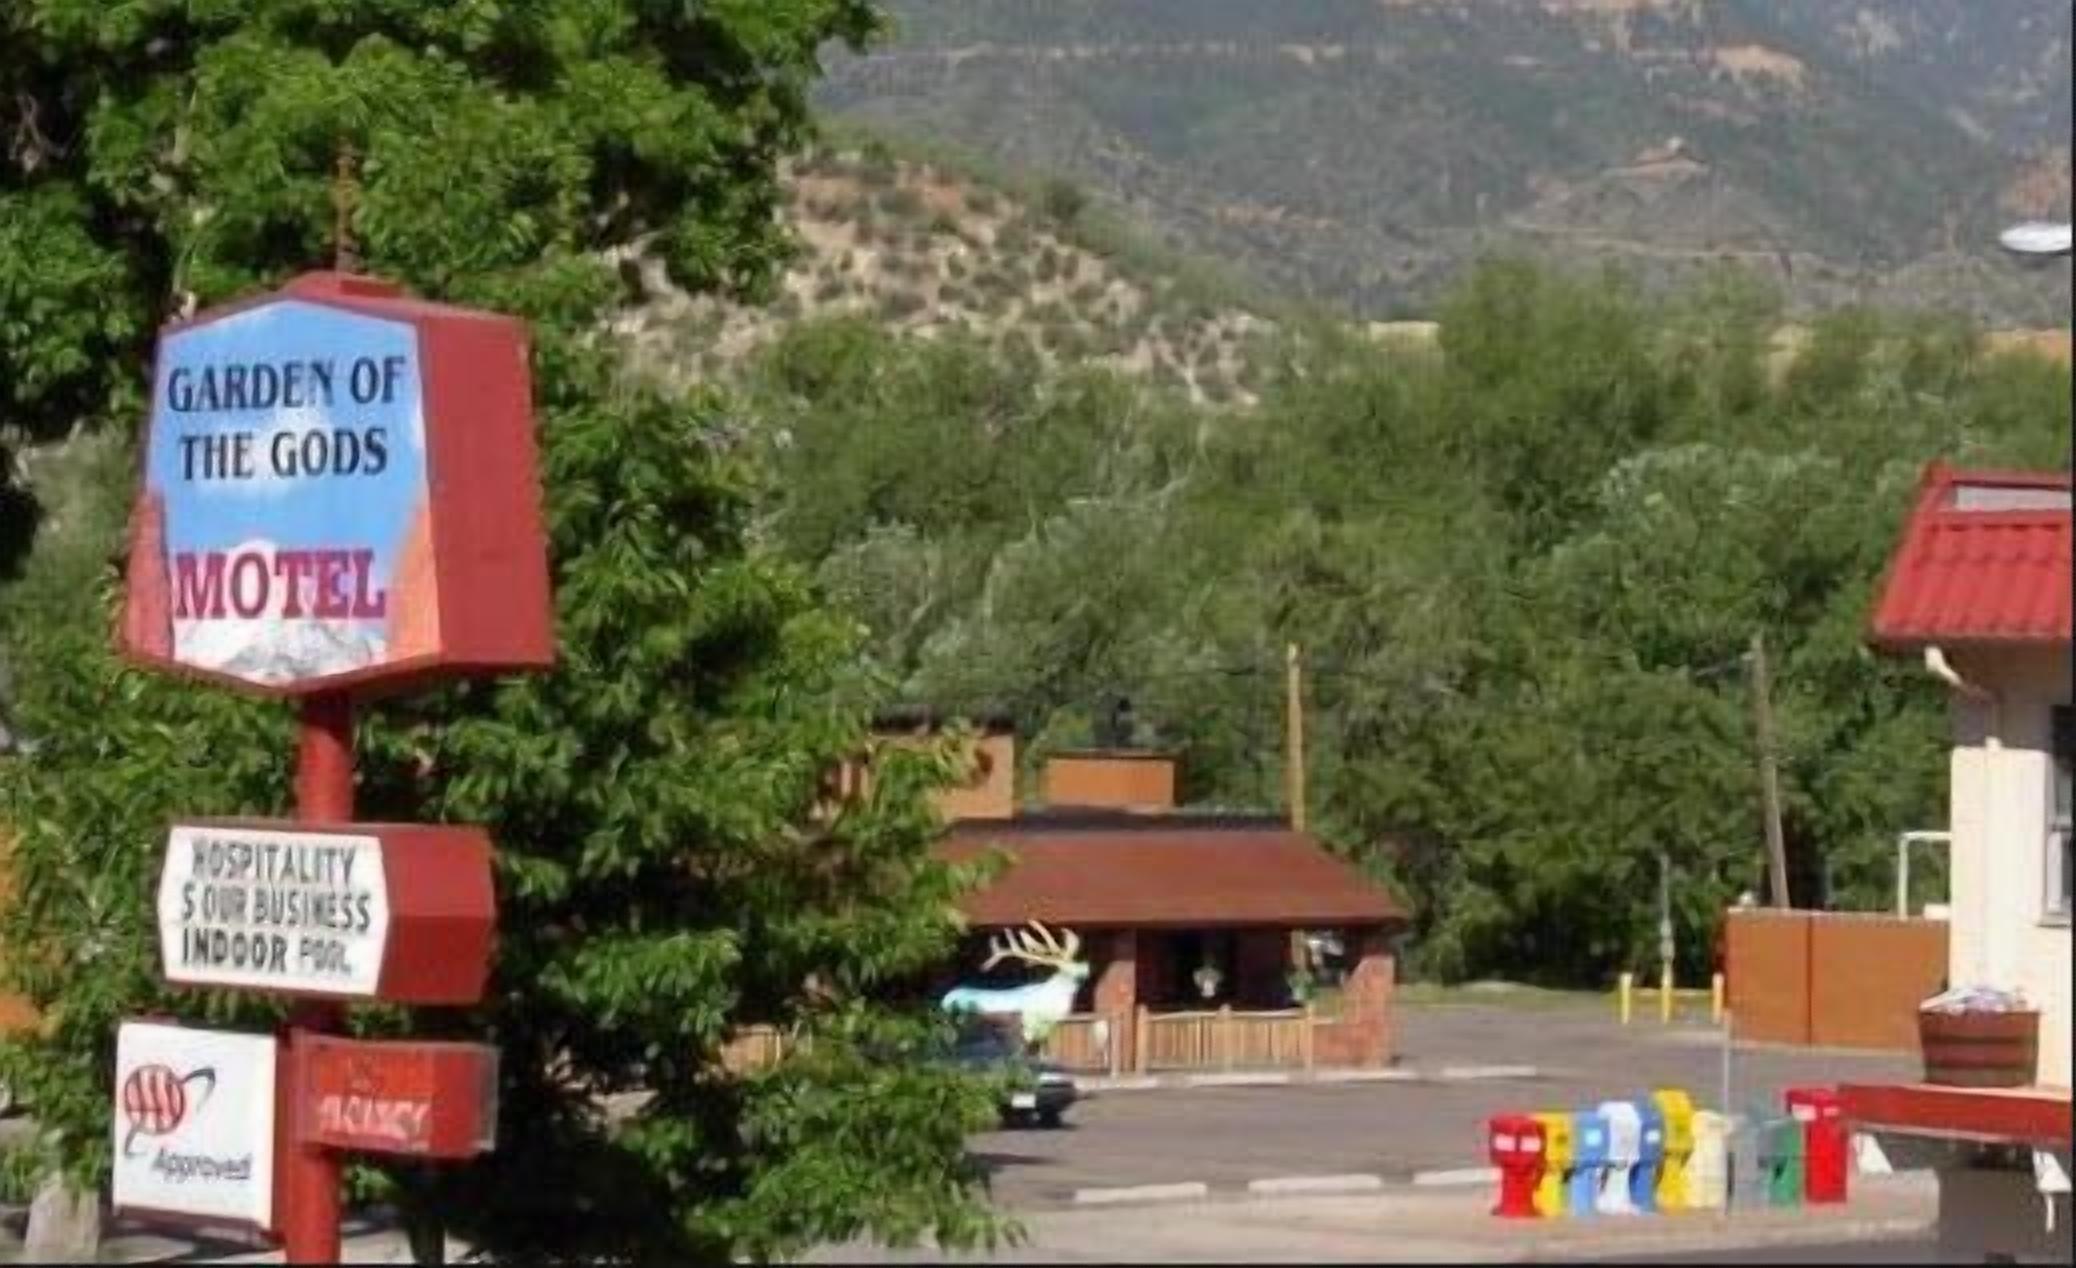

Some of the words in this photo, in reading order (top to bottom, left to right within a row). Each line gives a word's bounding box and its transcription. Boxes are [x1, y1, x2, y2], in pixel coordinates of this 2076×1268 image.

[168, 360, 335, 412] GARDEN
[349, 355, 405, 403] OF
[180, 432, 253, 480] THE
[271, 427, 388, 478] GODS
[174, 547, 386, 620] MOTEL
[192, 839, 357, 884] HOSPITALITY
[254, 887, 371, 933] BUSINESS
[182, 927, 288, 973] INDOOR
[152, 1148, 252, 1183] Approved
